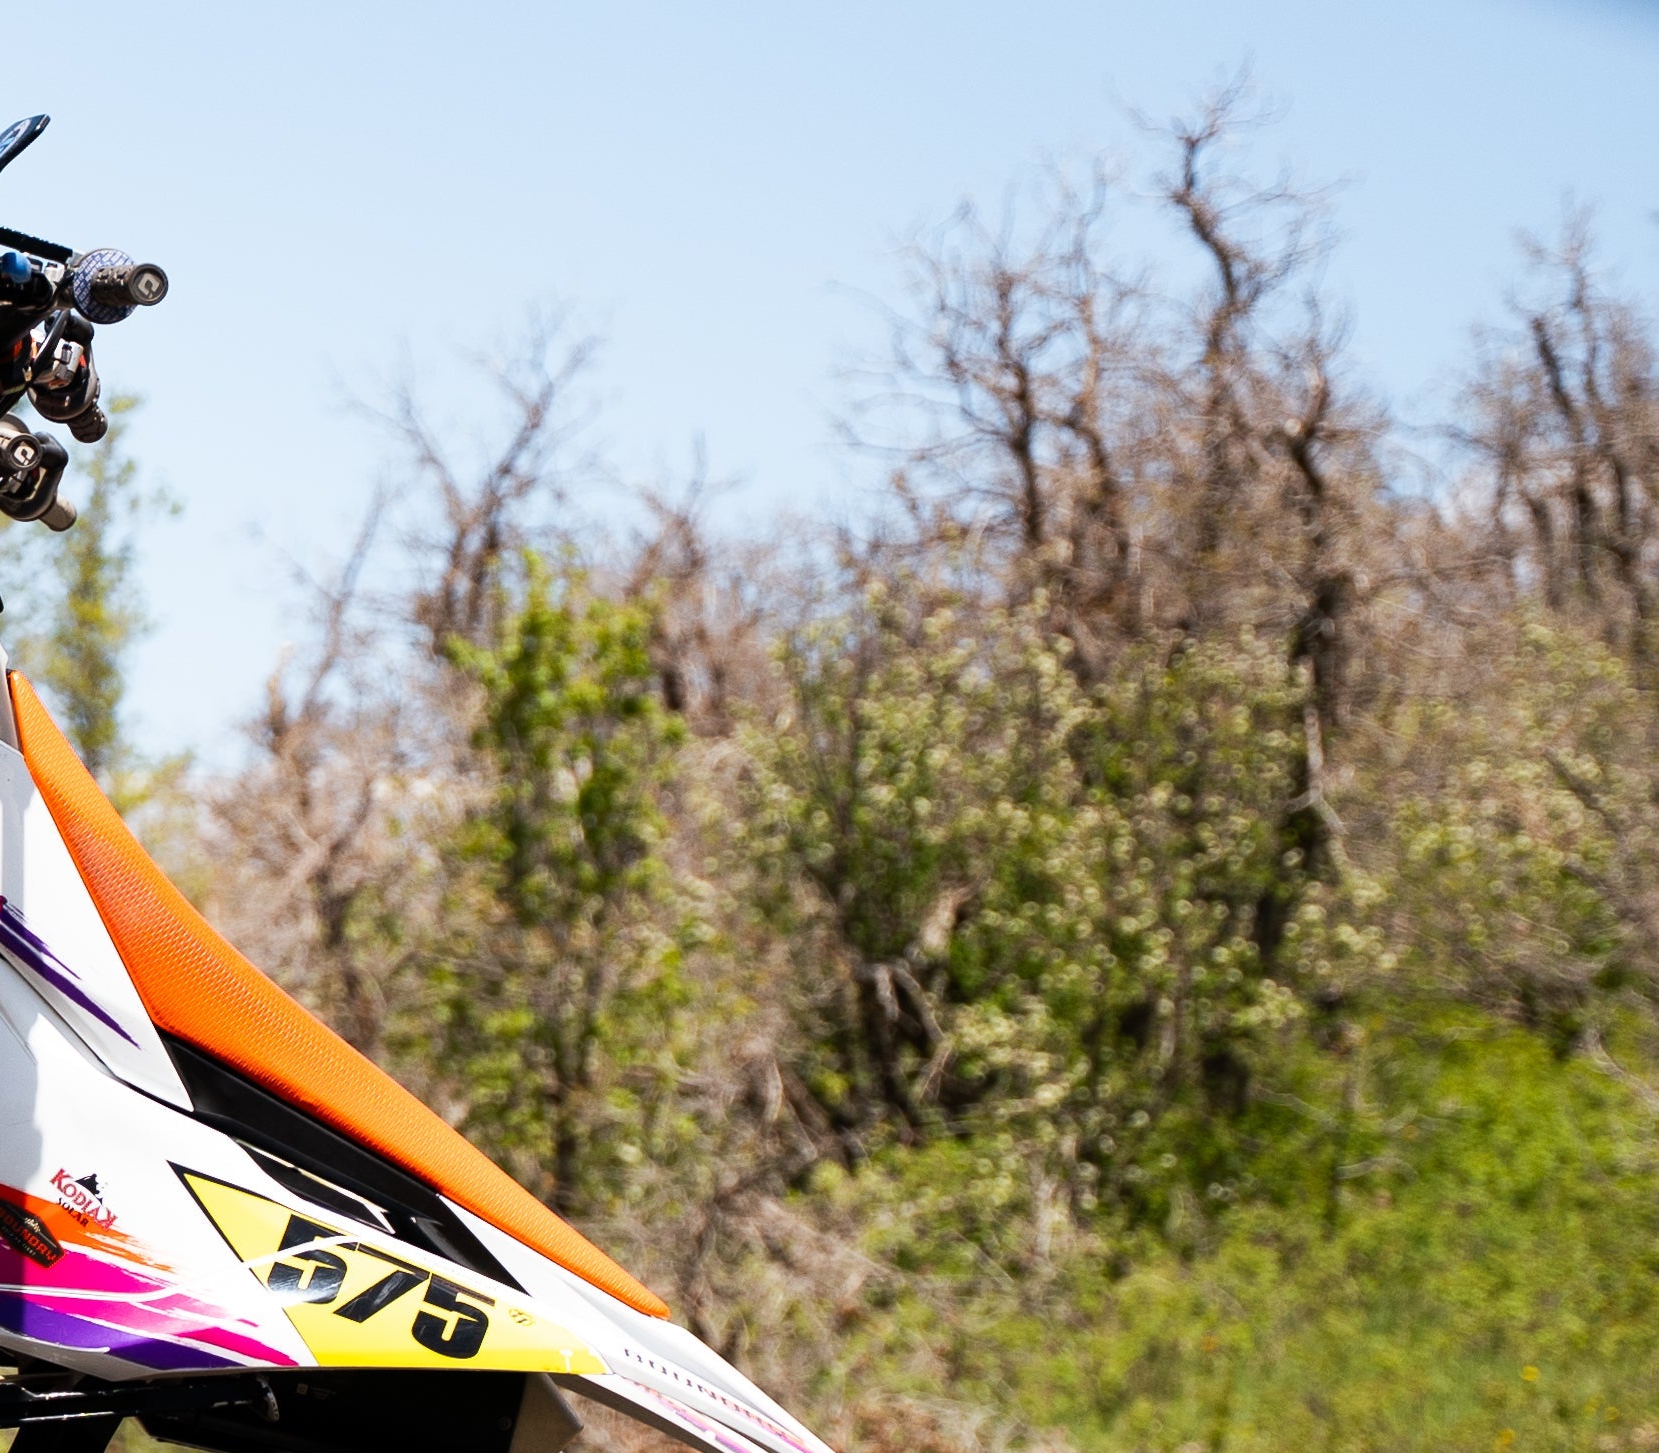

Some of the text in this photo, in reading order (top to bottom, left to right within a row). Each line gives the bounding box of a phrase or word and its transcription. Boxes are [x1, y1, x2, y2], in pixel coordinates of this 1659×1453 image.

[49, 1168, 119, 1232] KODIAK
[58, 1197, 89, 1228] SOLAR
[267, 1214, 496, 1359] 575
